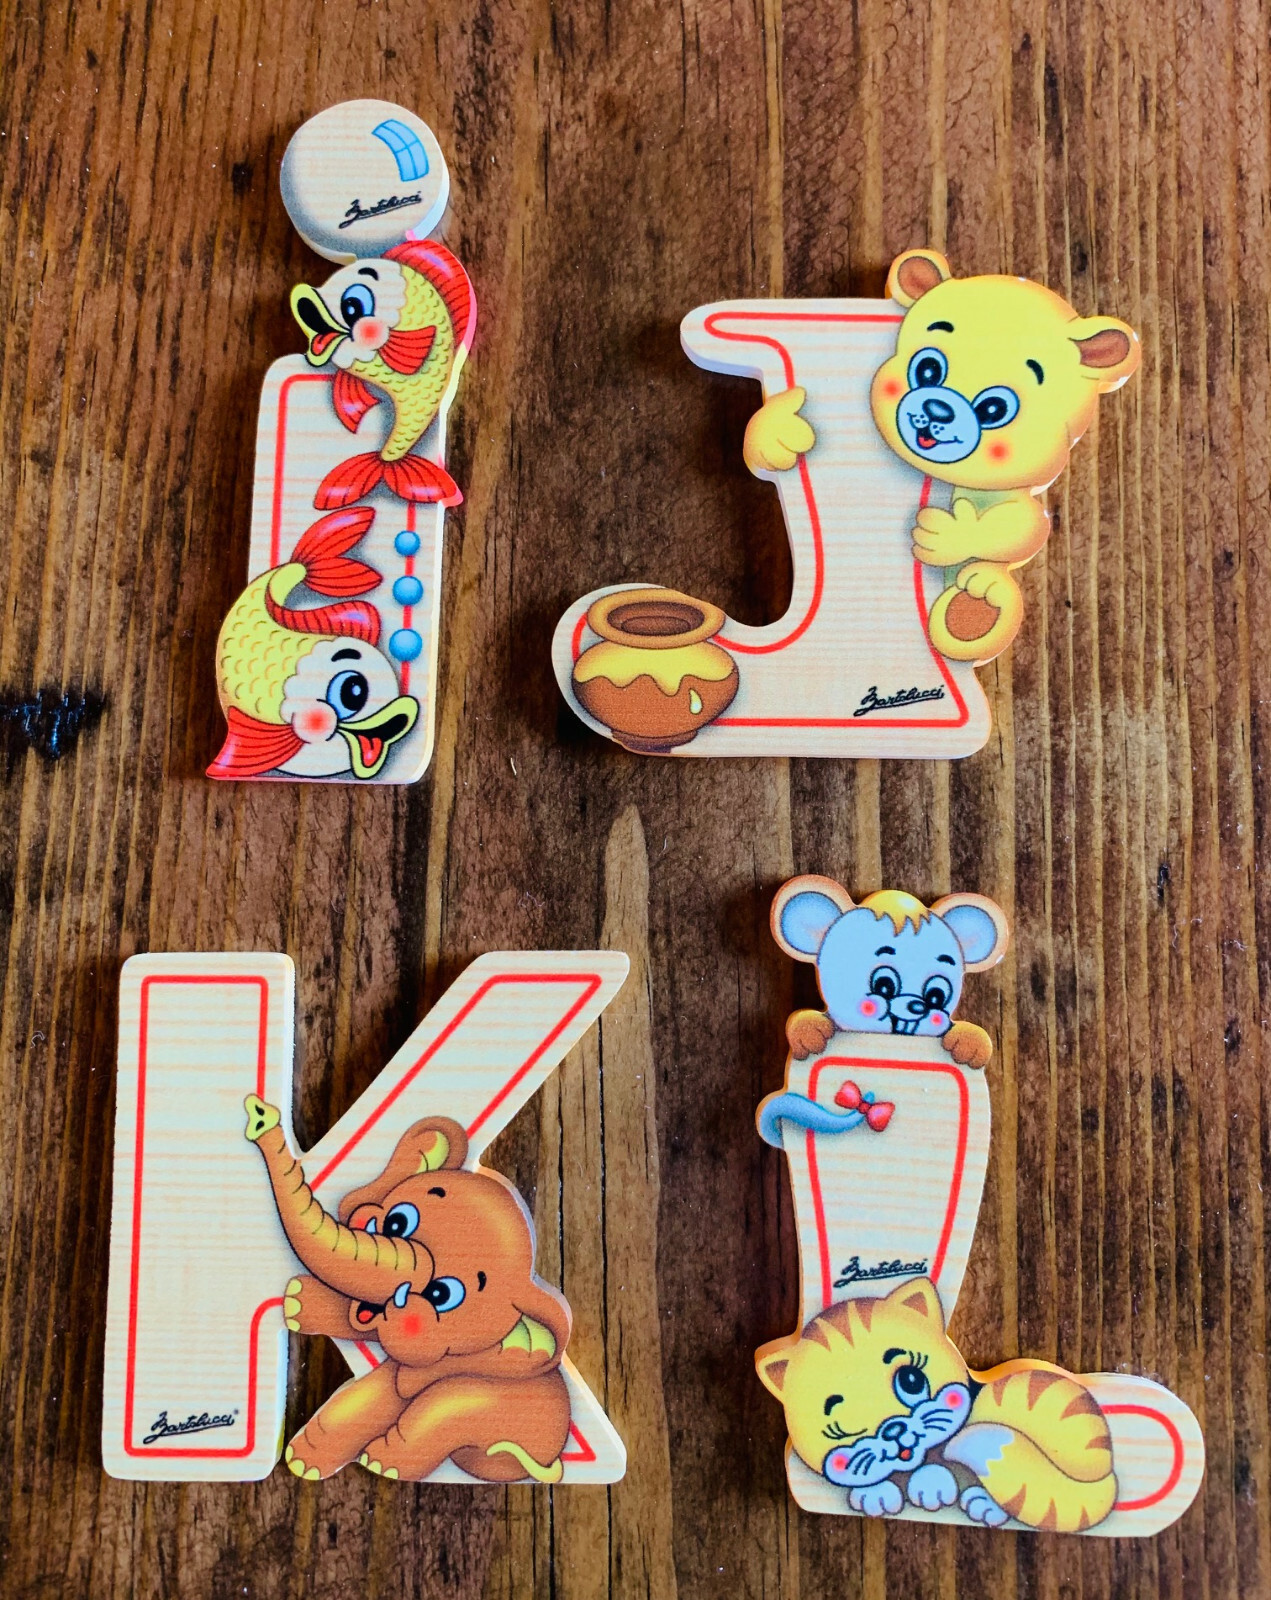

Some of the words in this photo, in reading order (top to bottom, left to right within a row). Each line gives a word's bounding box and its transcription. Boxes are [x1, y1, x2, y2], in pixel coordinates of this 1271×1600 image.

[551, 248, 1142, 762] J
[852, 685, 946, 717] Bartolucci
[101, 949, 632, 1486] K
[755, 873, 1207, 1539] L
[832, 1255, 929, 1288] Bartolucci
[142, 1409, 240, 1445] Bartolucci
